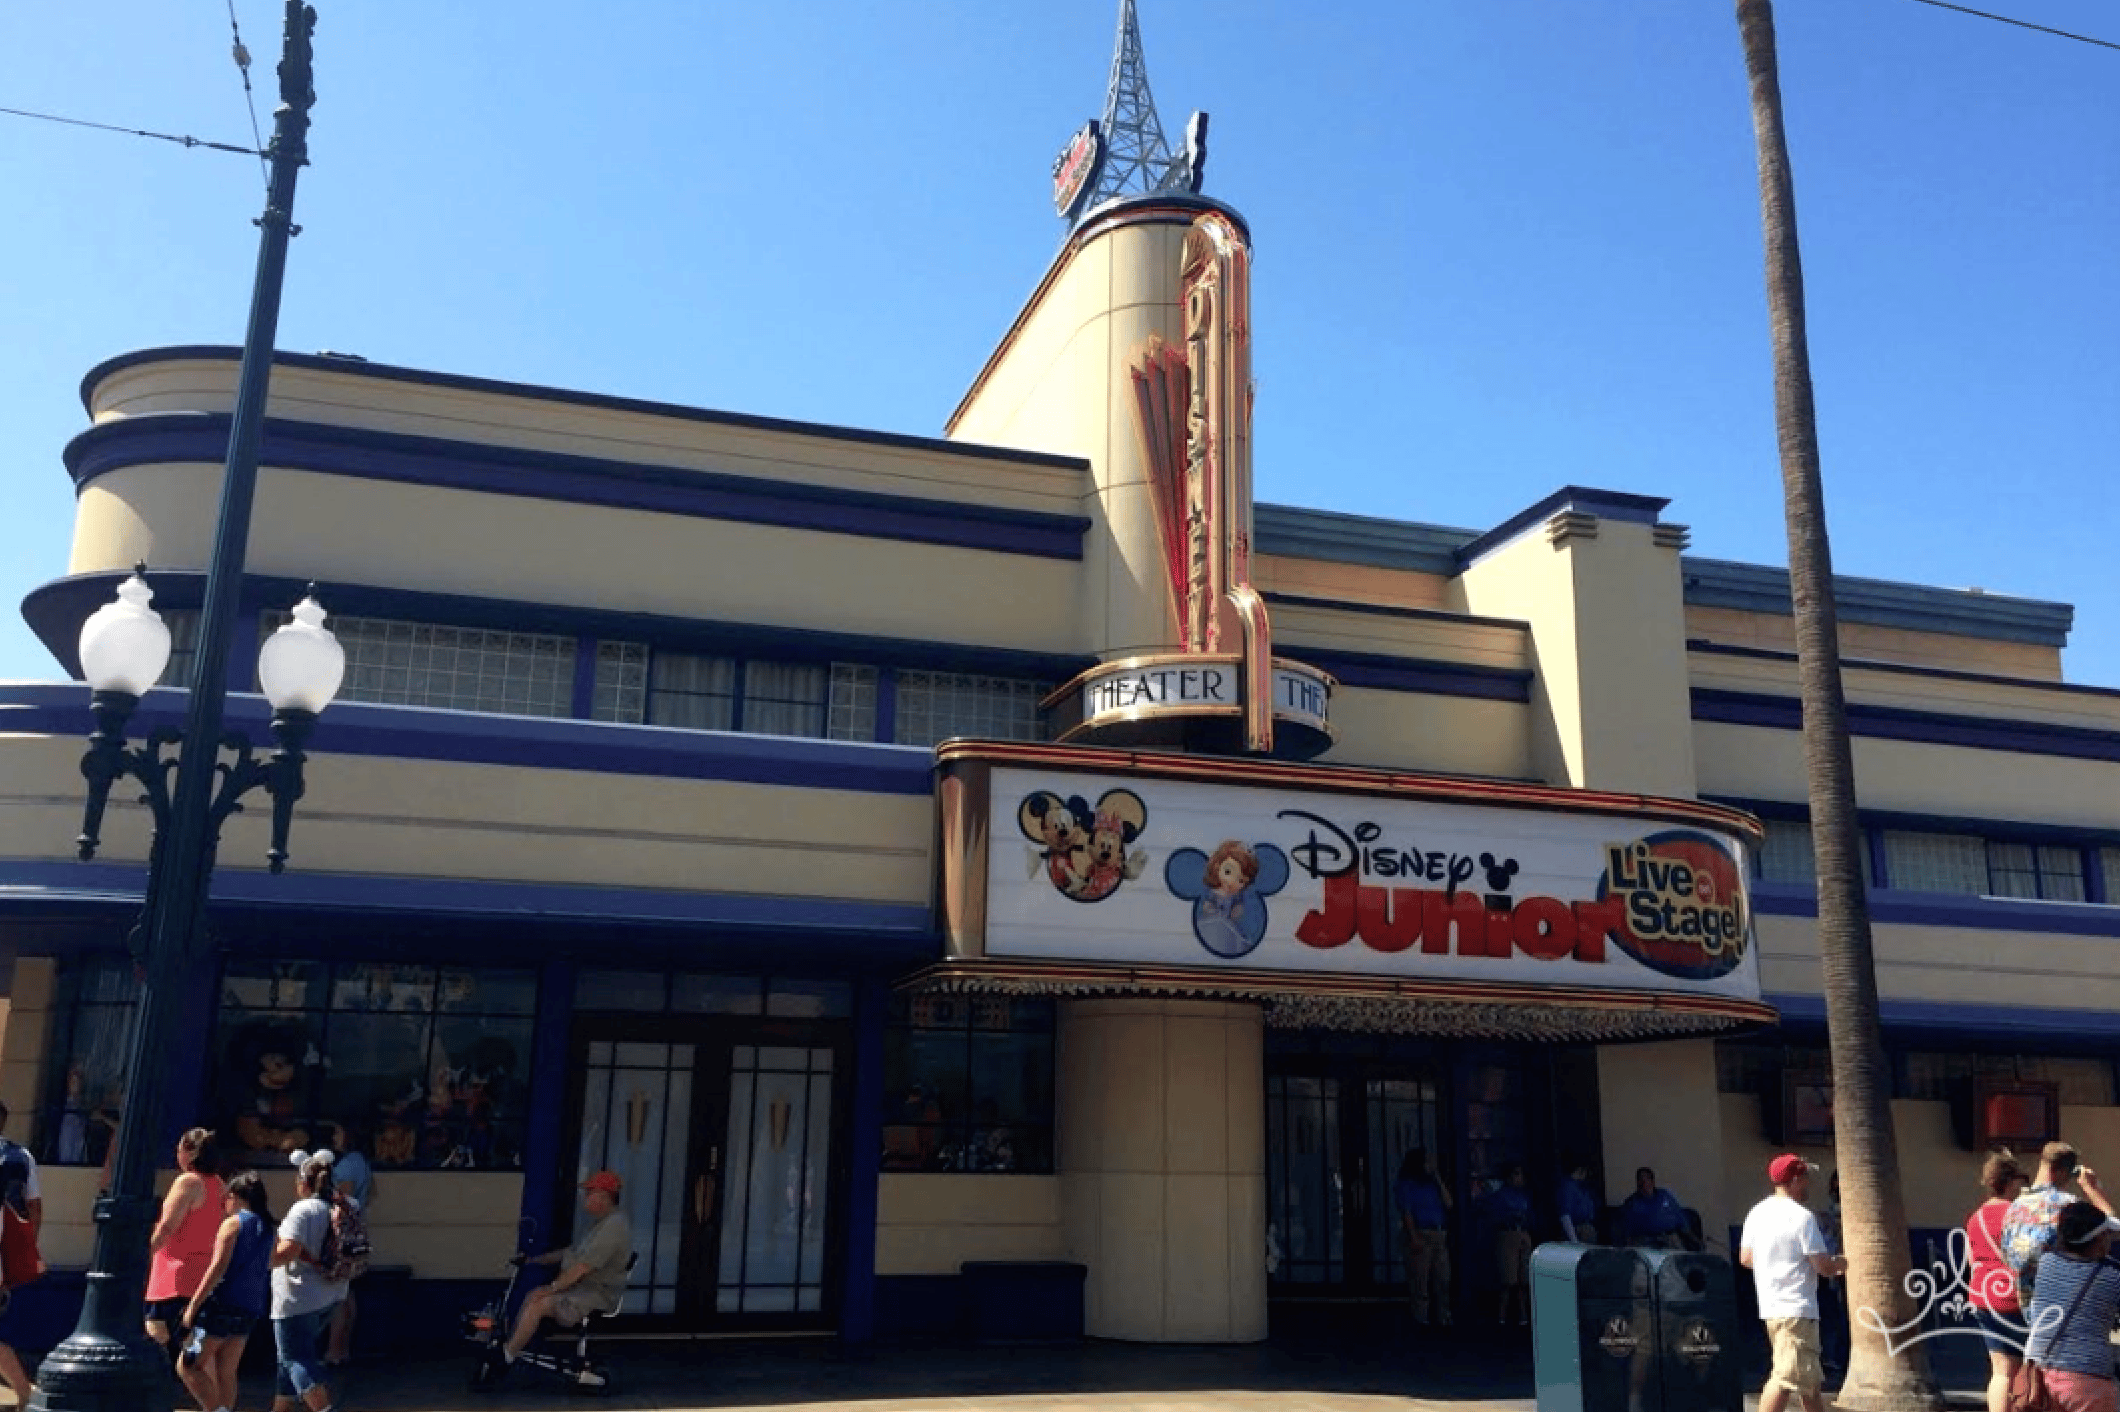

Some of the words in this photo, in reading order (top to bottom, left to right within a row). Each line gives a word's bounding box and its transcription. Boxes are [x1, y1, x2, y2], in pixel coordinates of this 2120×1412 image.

[1088, 669, 1225, 714] THEATER
[1278, 675, 1324, 717] THE
[1608, 842, 1695, 898] Live
[1294, 869, 1626, 964] Junior
